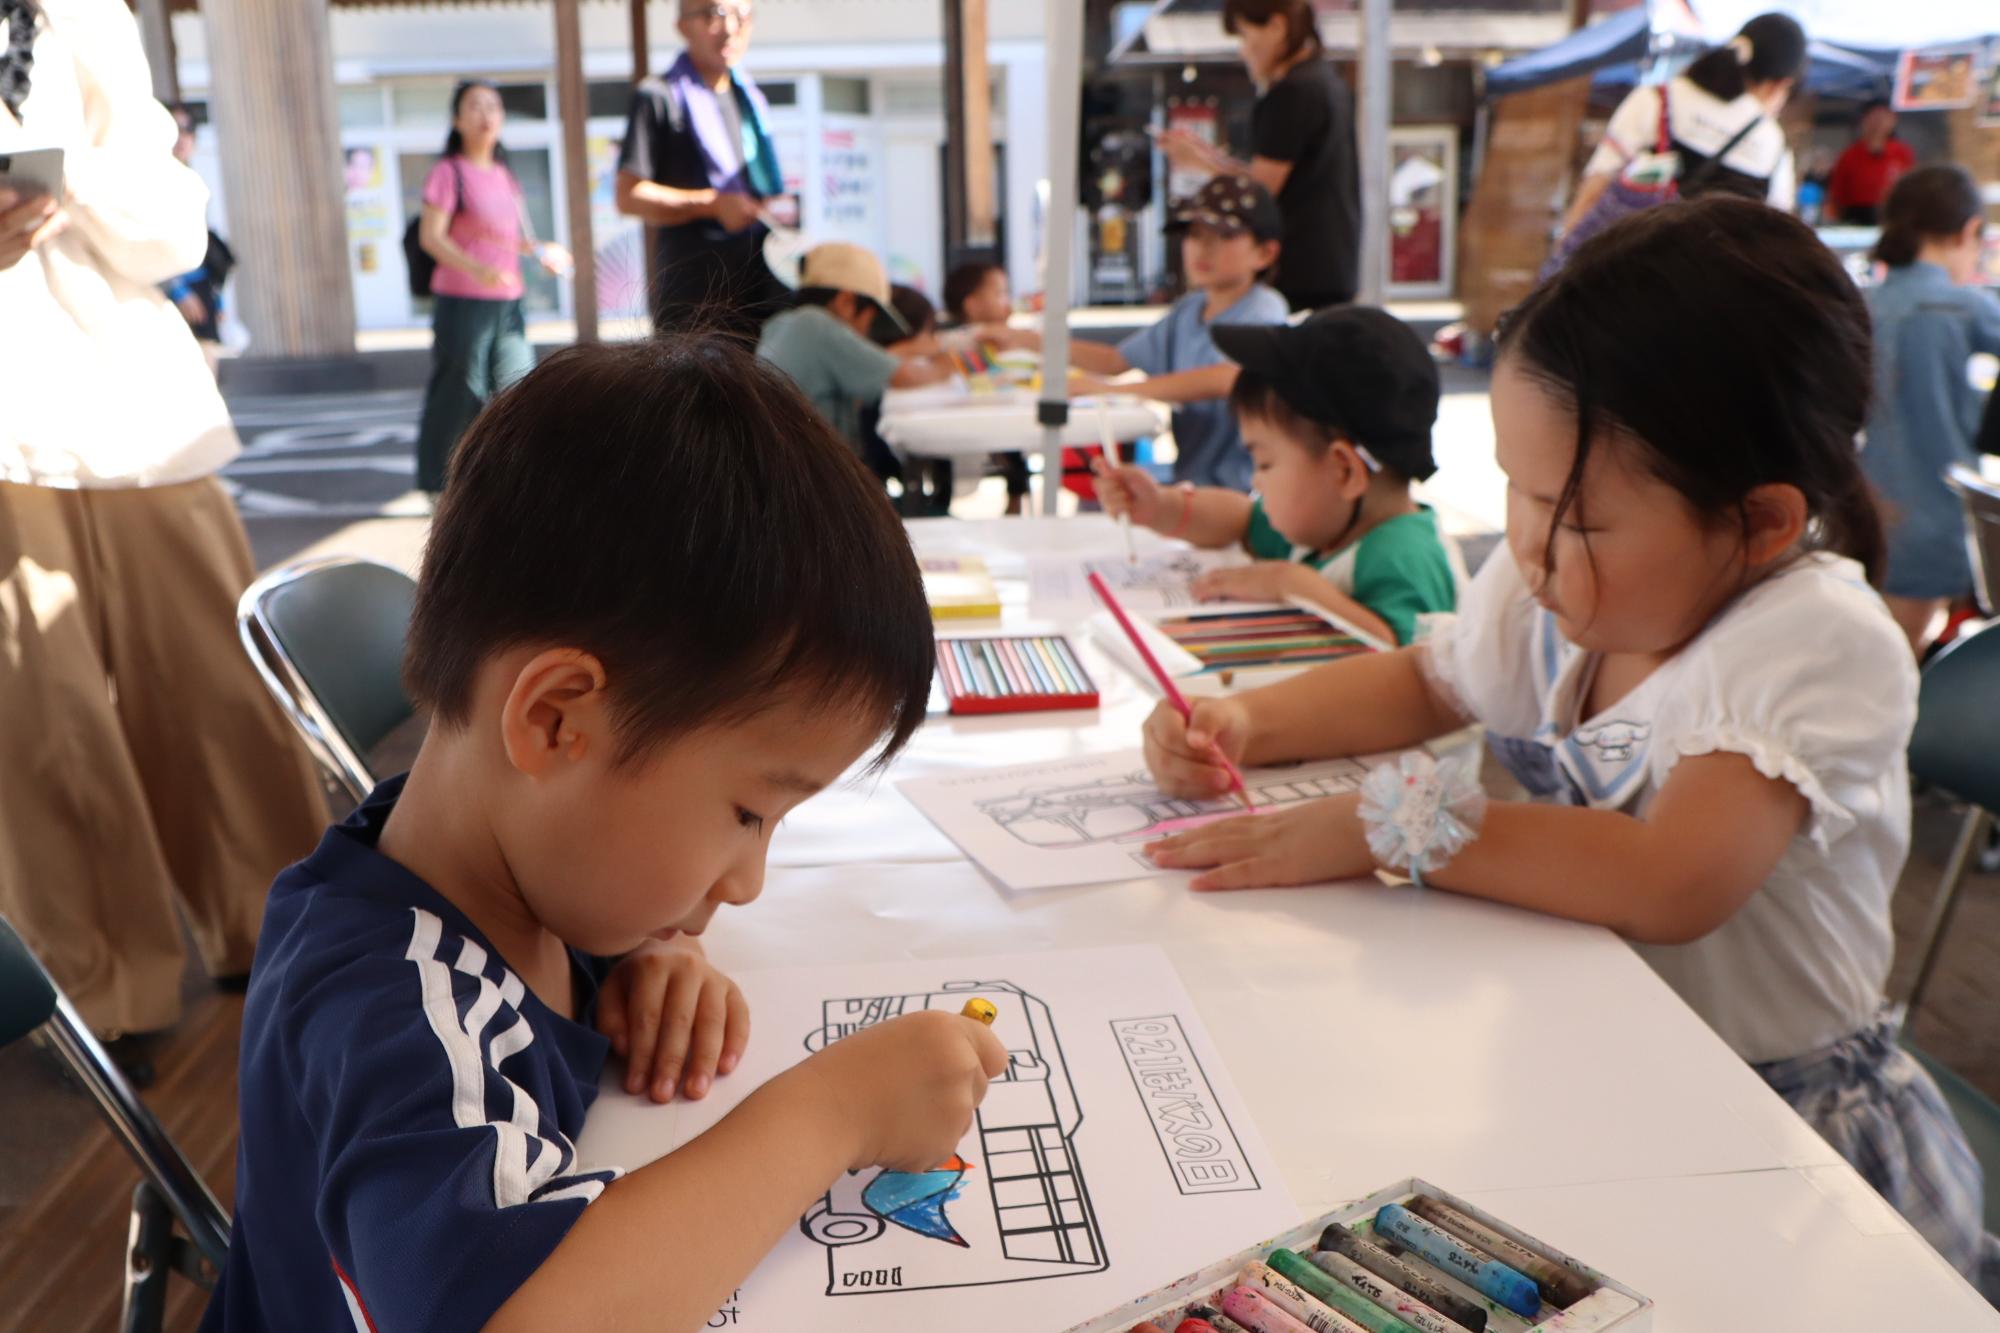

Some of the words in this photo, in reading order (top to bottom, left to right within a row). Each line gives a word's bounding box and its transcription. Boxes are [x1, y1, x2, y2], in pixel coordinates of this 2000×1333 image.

[1121, 1021, 1239, 1187] 9.21はバスの日
